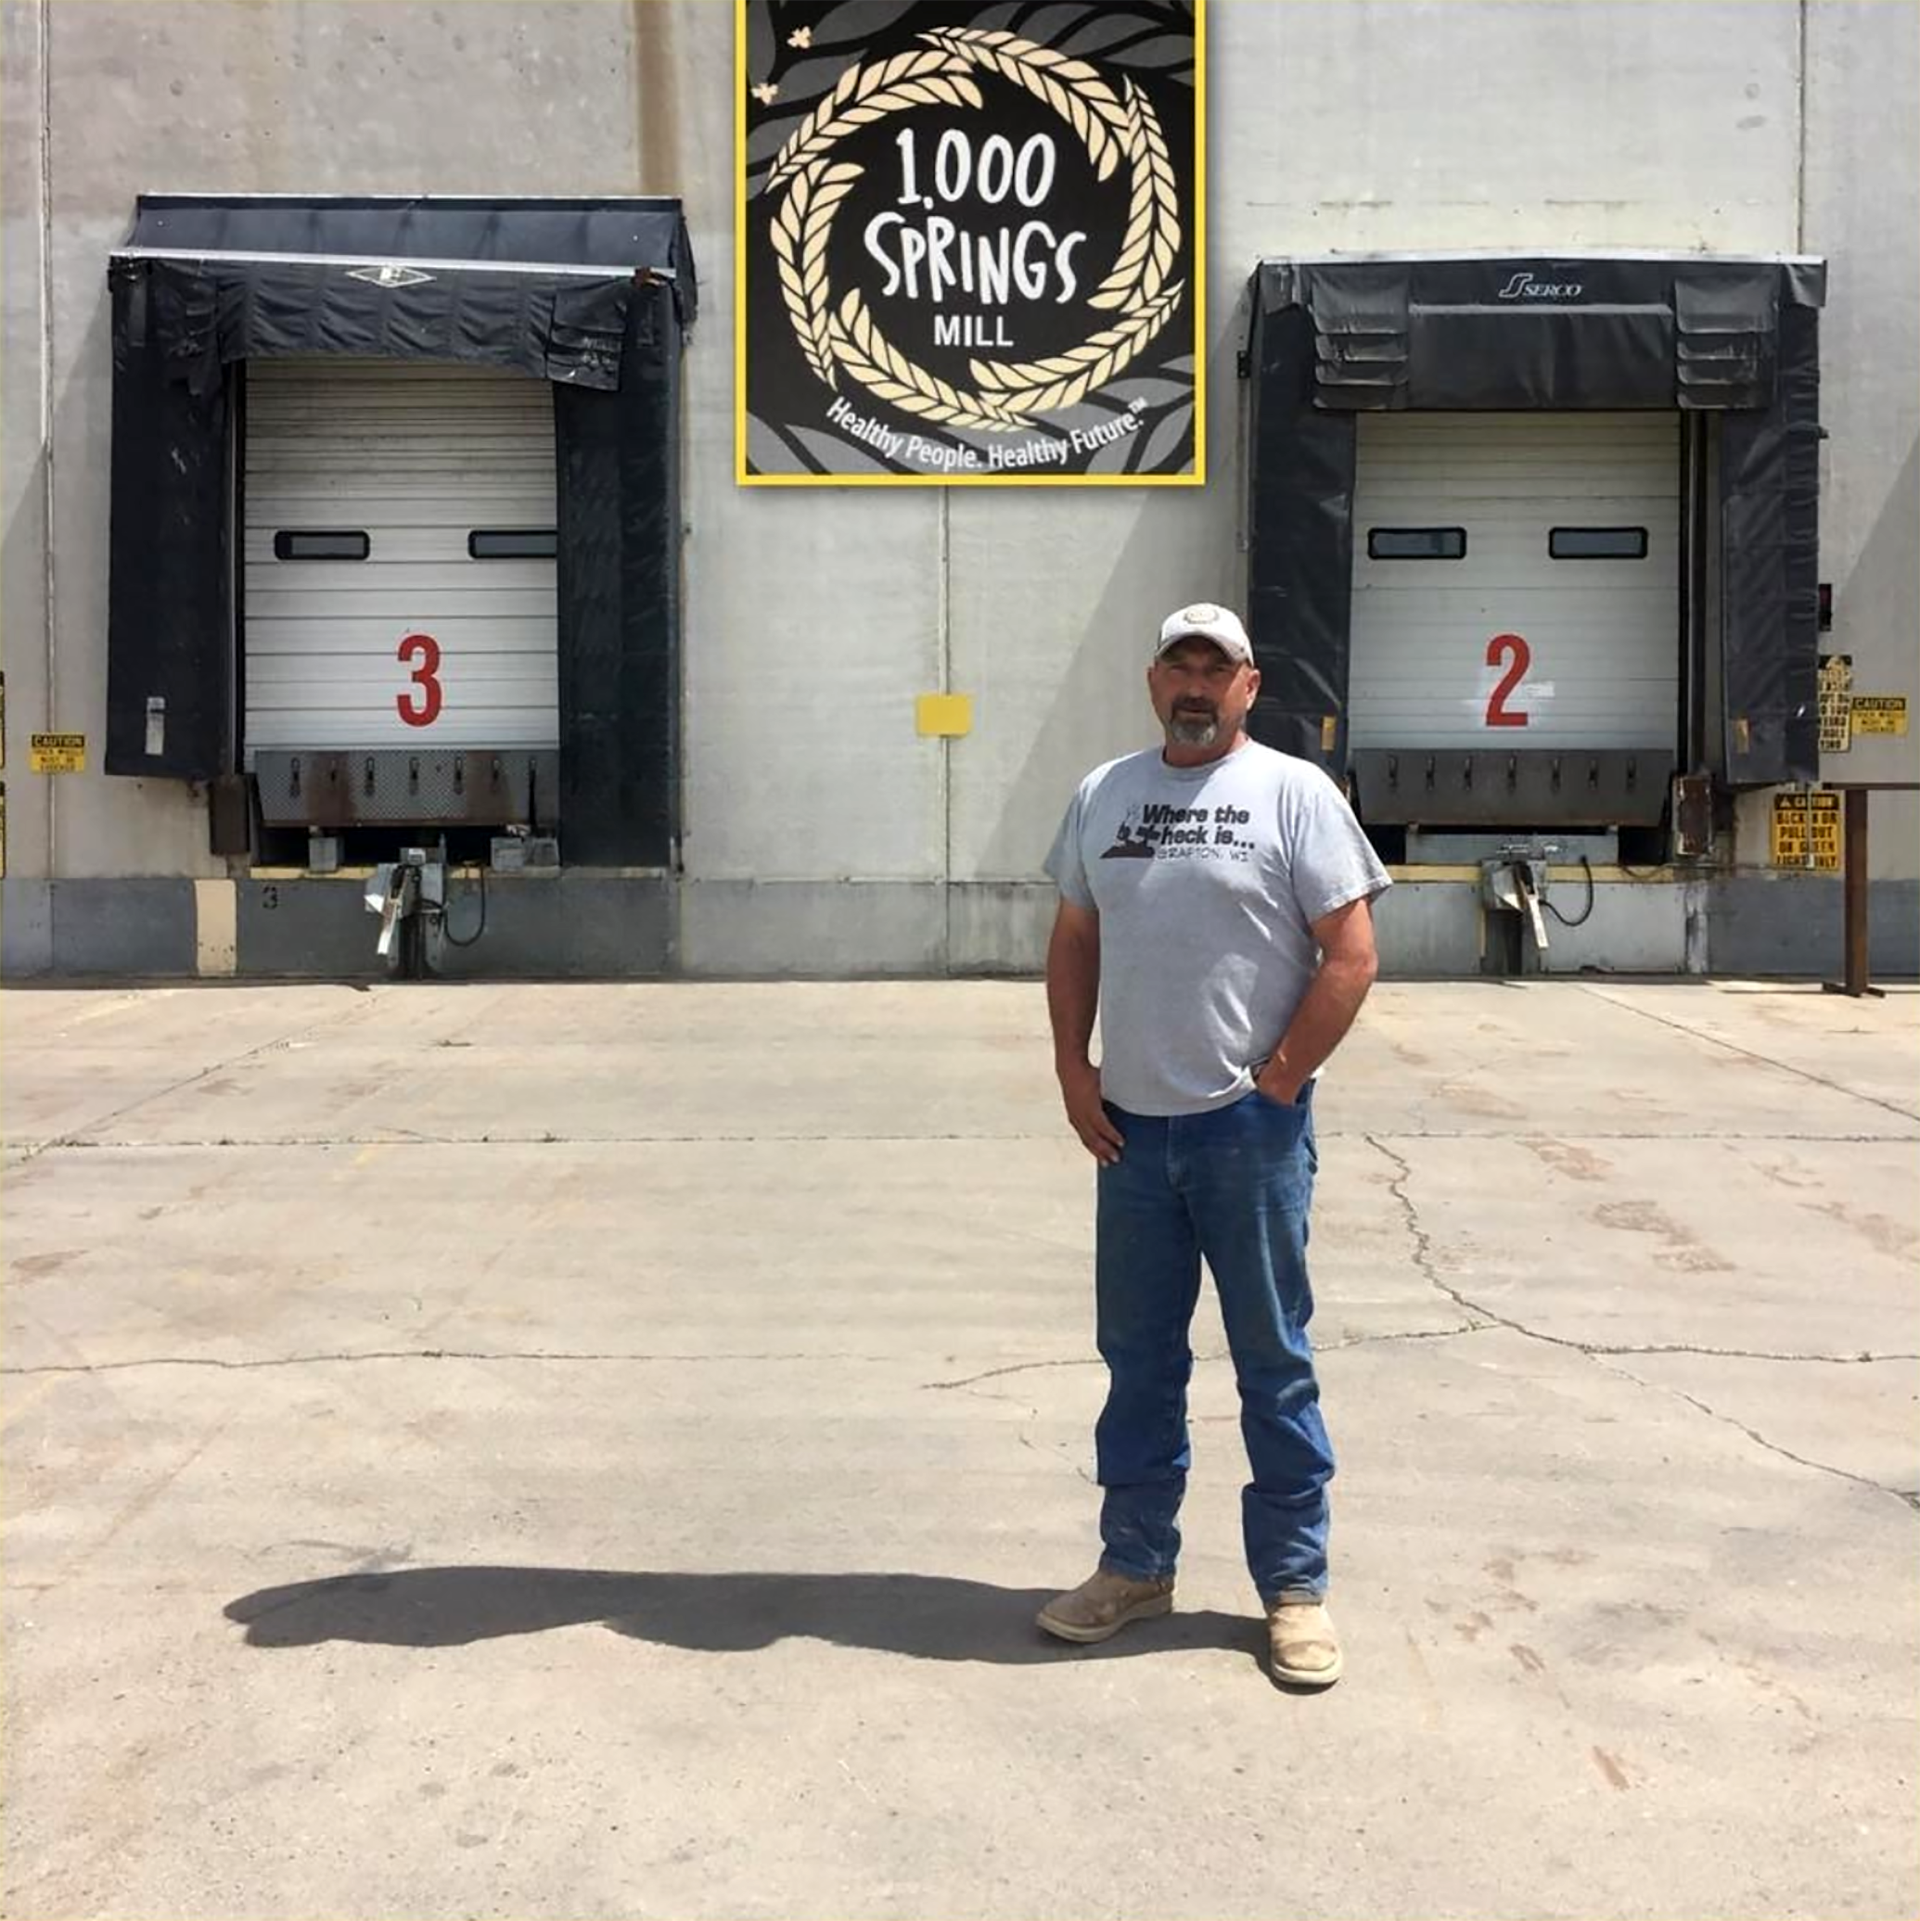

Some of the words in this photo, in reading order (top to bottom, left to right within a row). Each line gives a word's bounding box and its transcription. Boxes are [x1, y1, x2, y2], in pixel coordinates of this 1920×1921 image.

[896, 127, 1056, 209] 1,000
[864, 211, 1087, 304] SPRINGS
[933, 315, 1014, 347] MILL
[826, 396, 902, 458] Healthy
[904, 434, 983, 472] People.
[988, 438, 1069, 468] Healthy
[396, 634, 443, 728] 3
[1485, 633, 1531, 727] 2
[1142, 804, 1209, 824] Where
[1214, 804, 1250, 824] the
[1161, 825, 1210, 846] heck
[262, 885, 279, 910] 3
